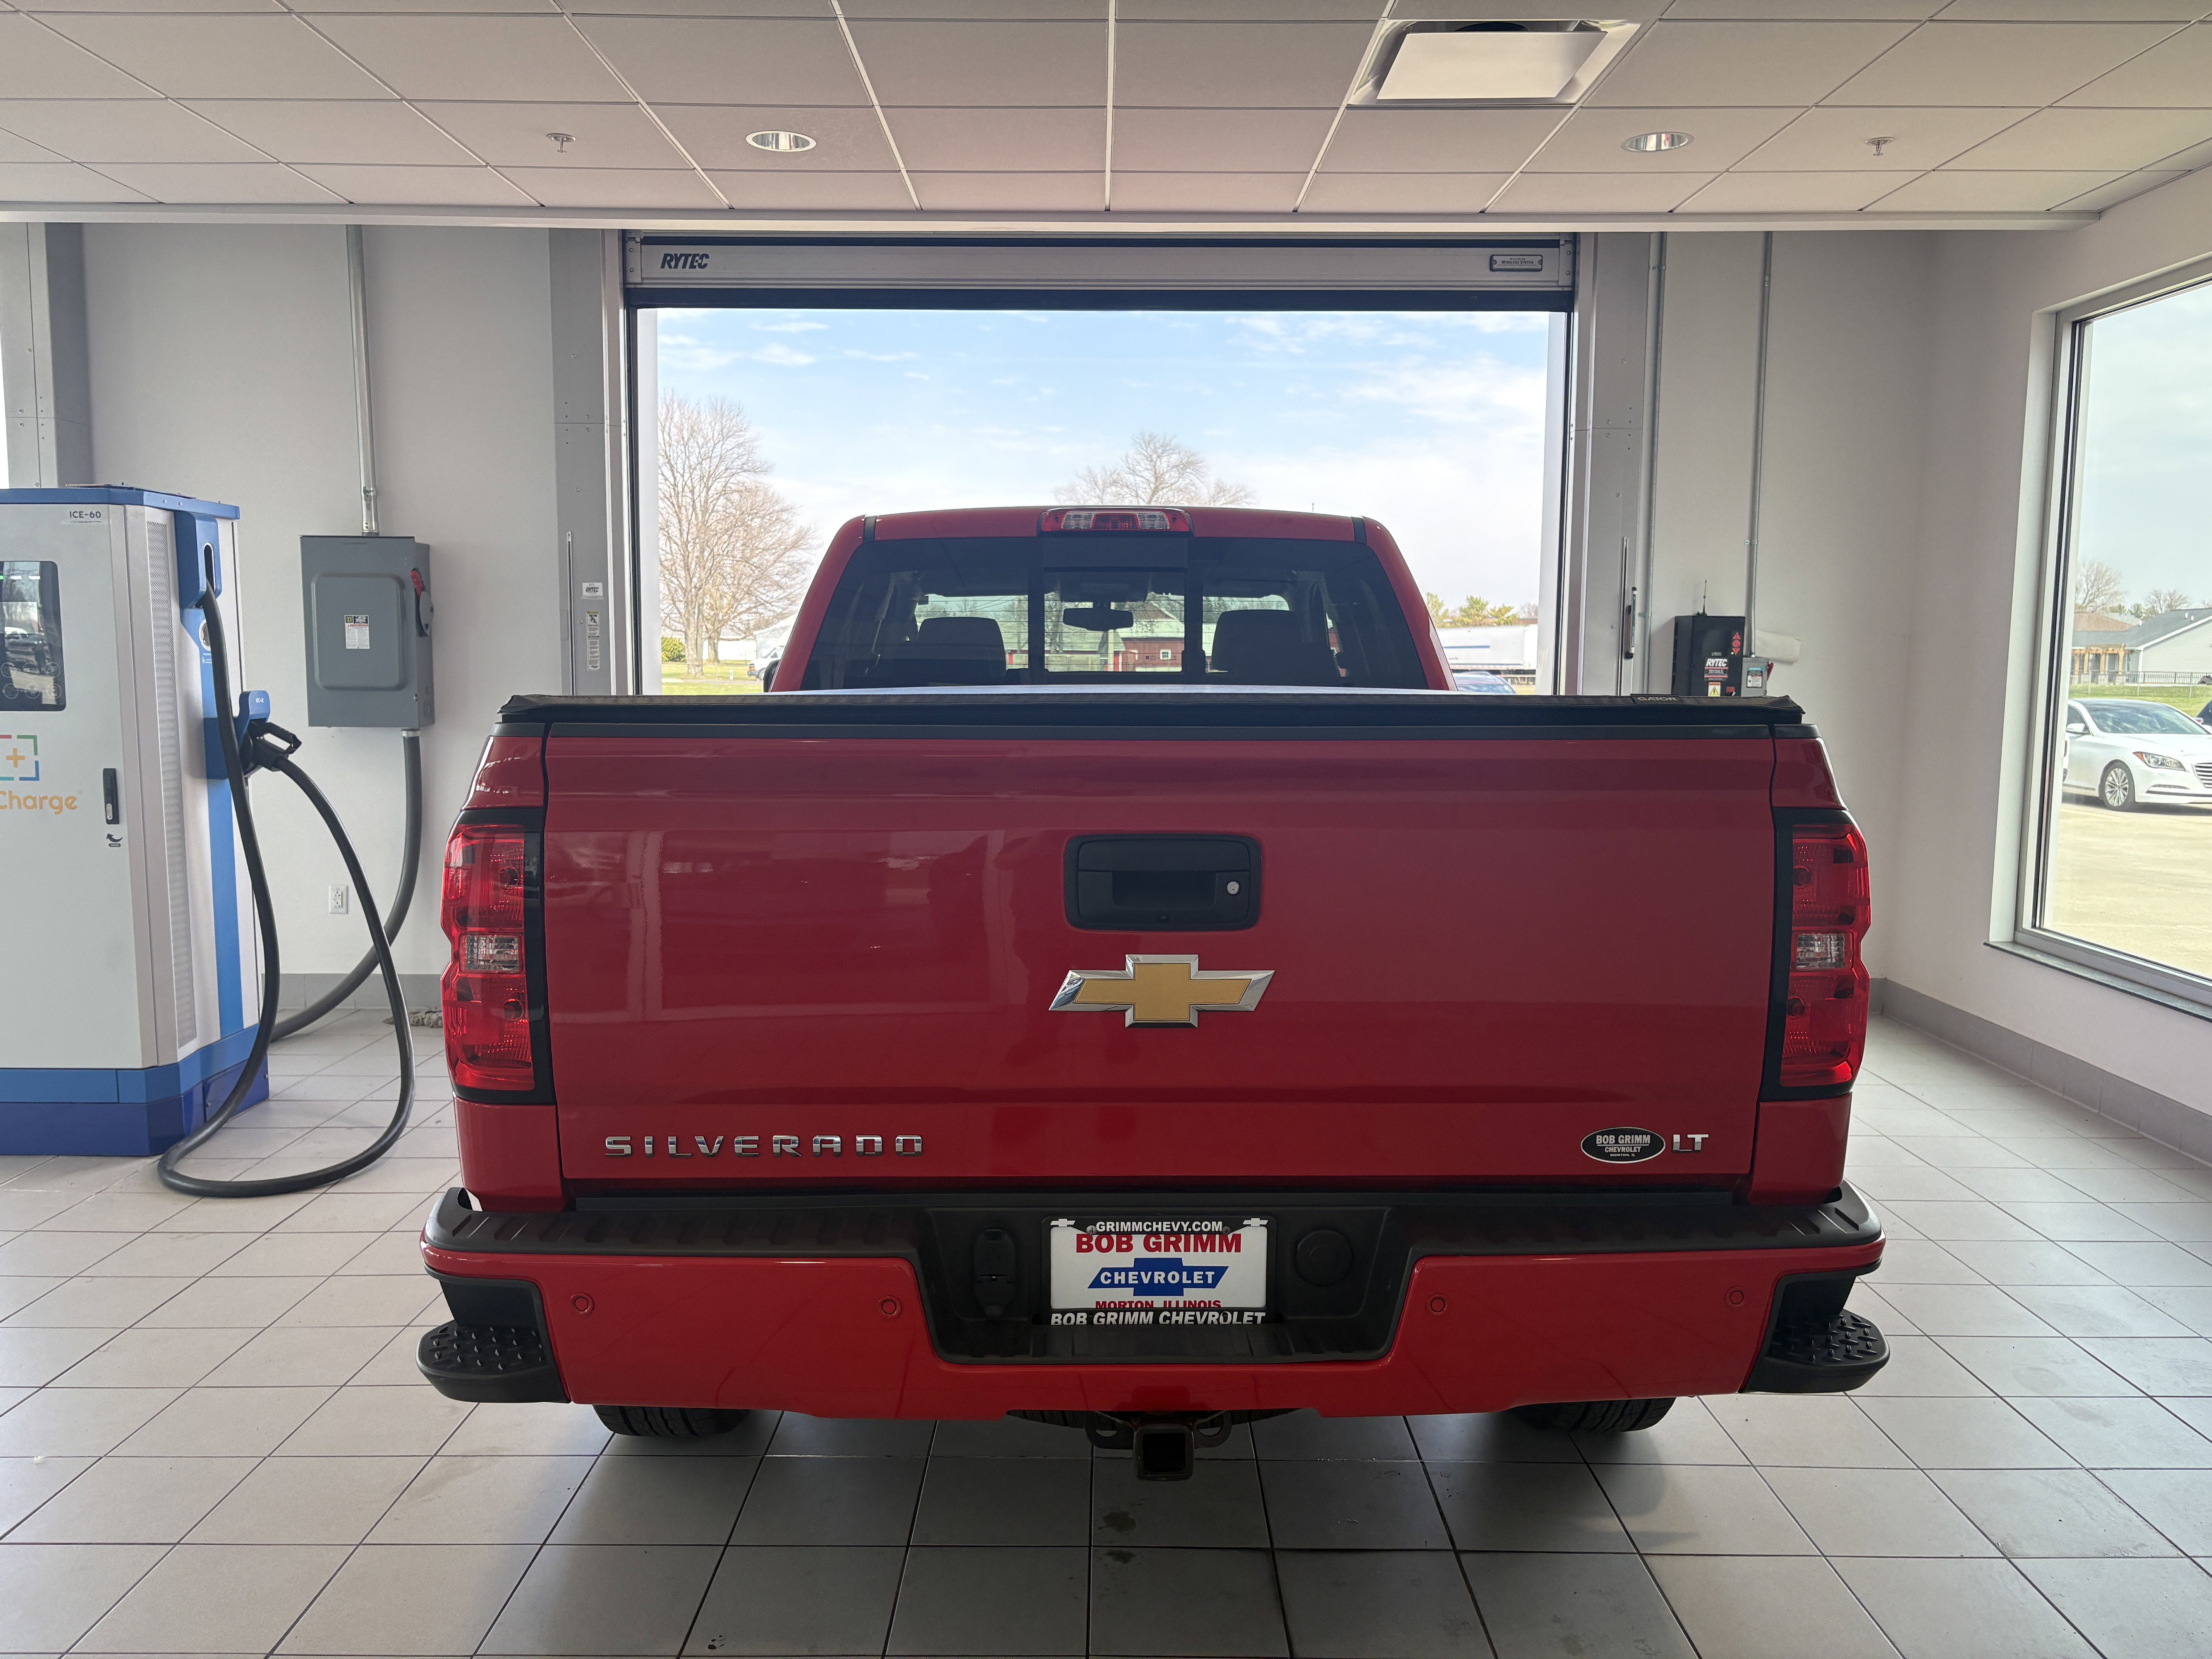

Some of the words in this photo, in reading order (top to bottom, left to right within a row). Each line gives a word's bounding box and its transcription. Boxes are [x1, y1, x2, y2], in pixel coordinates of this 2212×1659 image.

[661, 253, 709, 269] RYTEC
[1706, 658, 1727, 667] RYTEC
[605, 1135, 922, 1157] SILVERADO
[1596, 1135, 1615, 1144] BOB
[1618, 1135, 1650, 1144] GRIMM
[1672, 1134, 1709, 1152] LT
[1096, 1221, 1223, 1232] GRIMMCHEVY.COM
[1076, 1233, 1133, 1253] BOB
[1143, 1233, 1242, 1253] GRIMM
[1100, 1271, 1215, 1285] CHEVROLET
[1051, 1313, 1087, 1325] BOB
[1093, 1312, 1154, 1325] GRIMM
[1159, 1311, 1266, 1325] CHEVROLET
